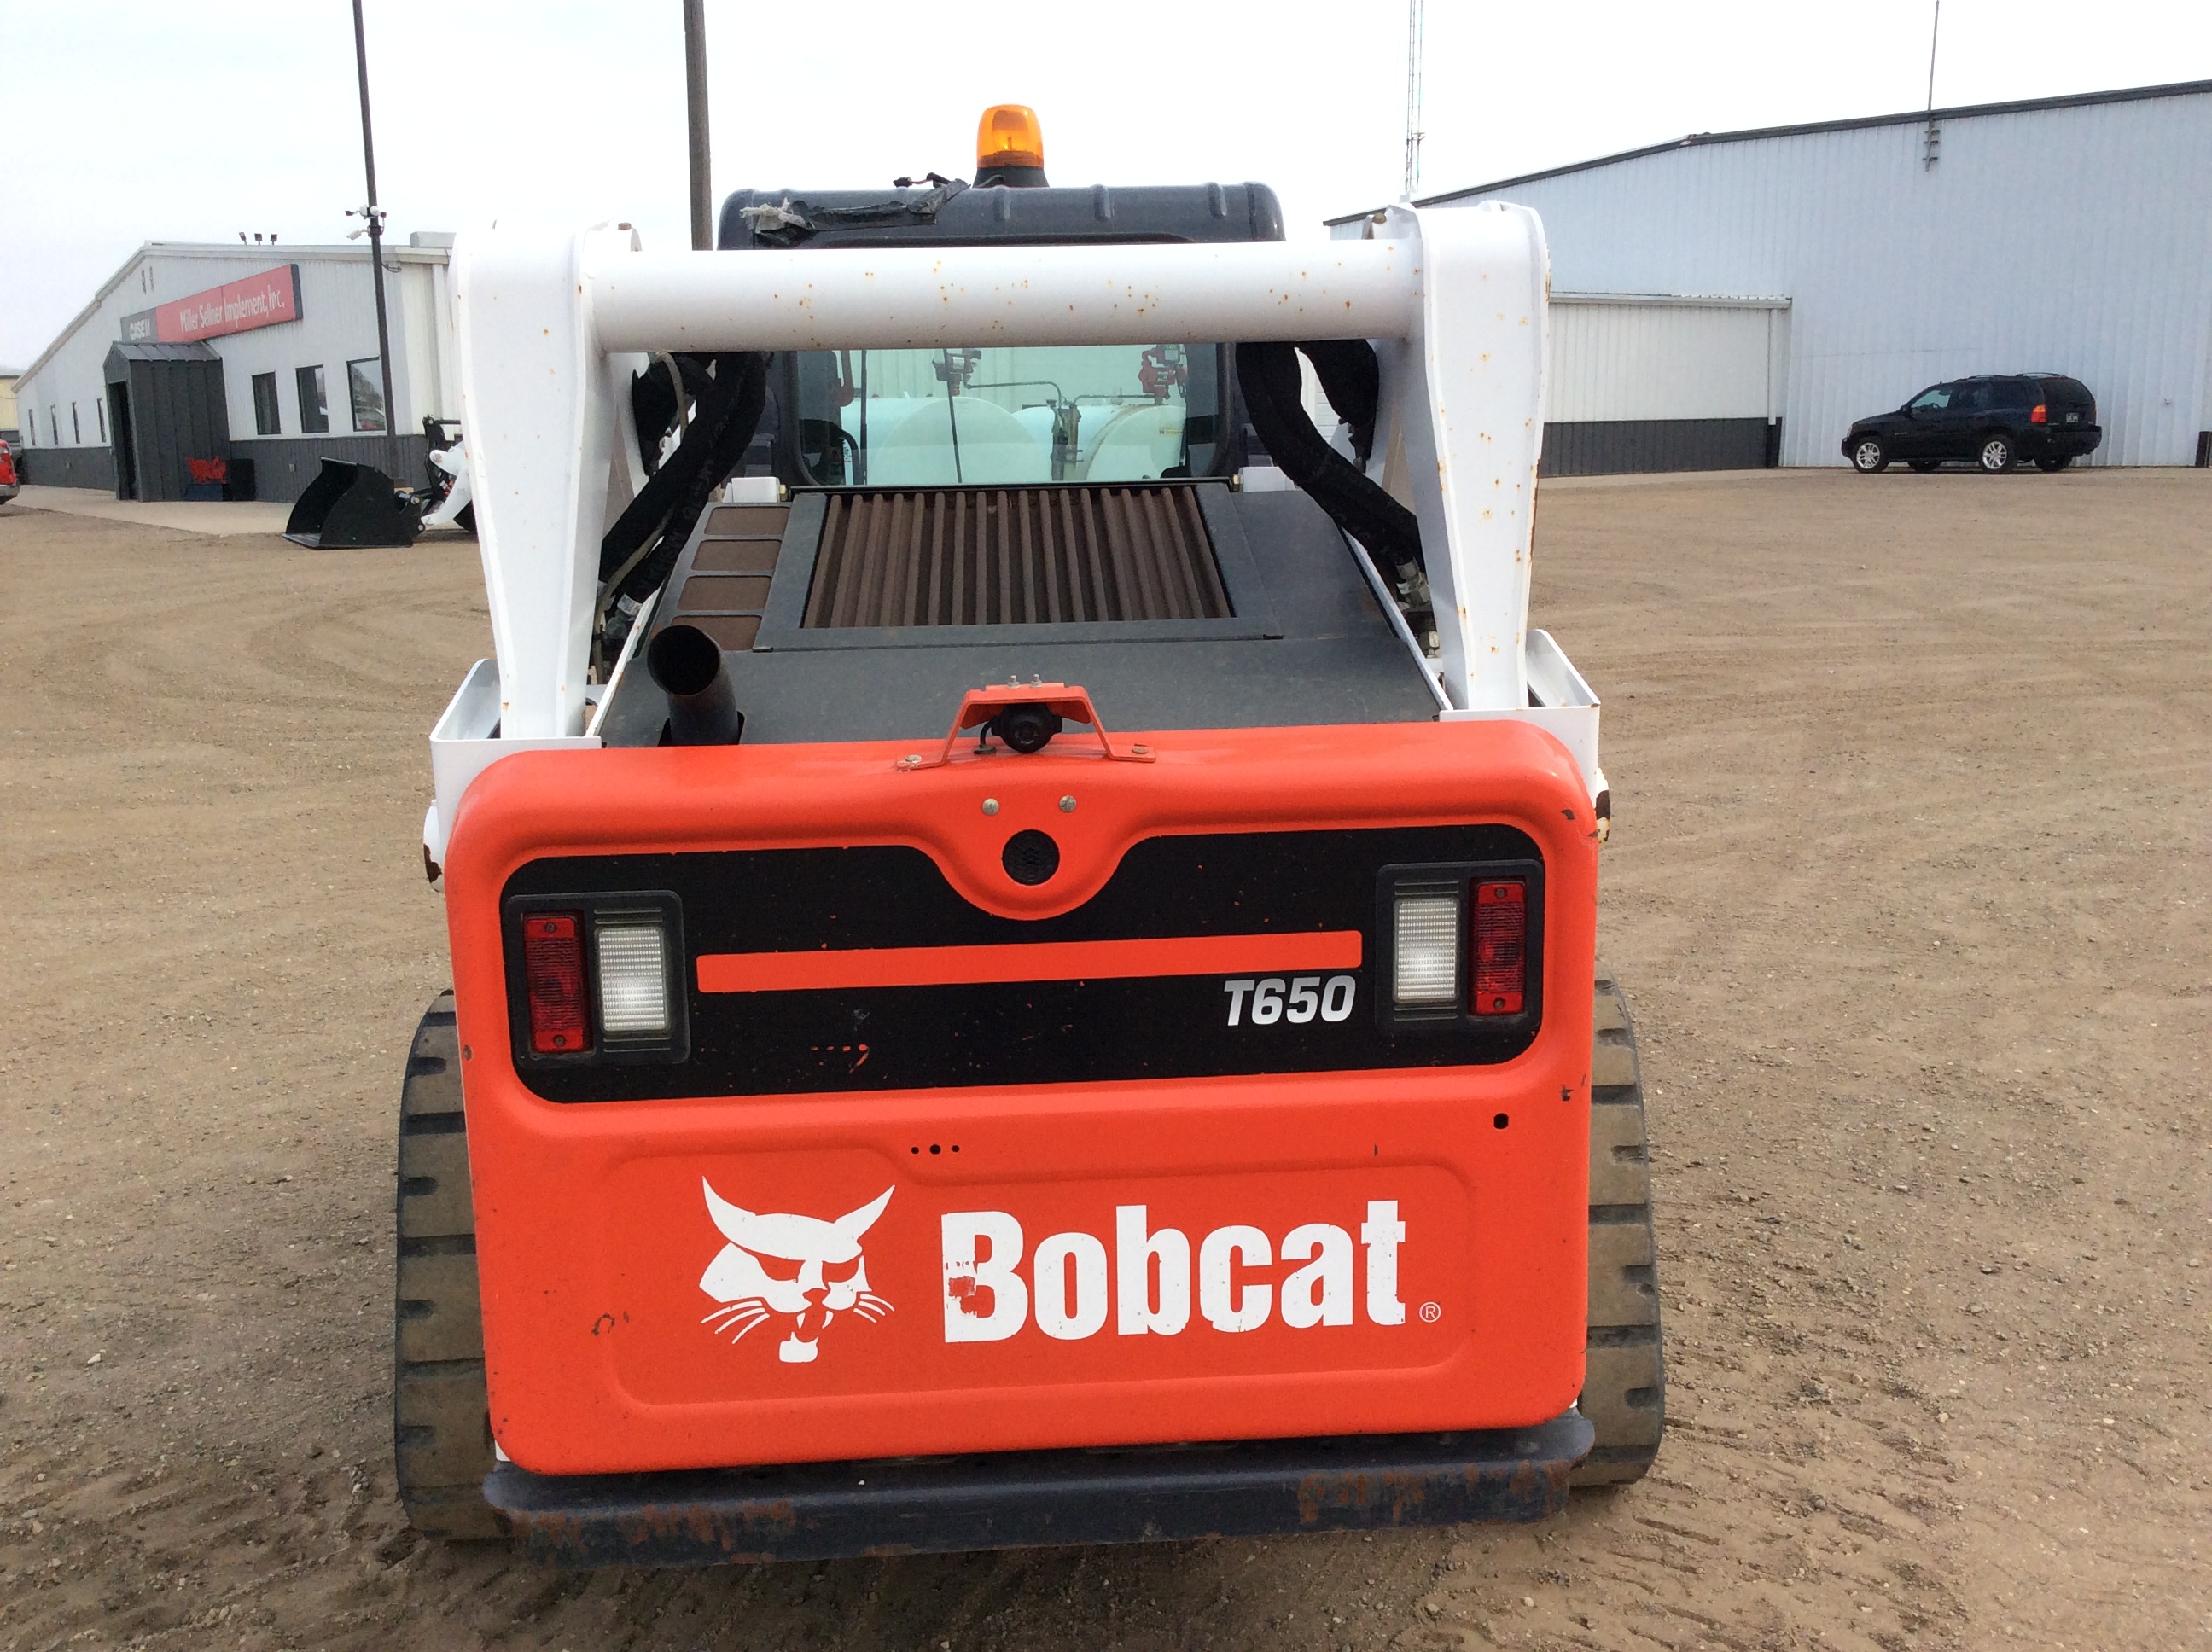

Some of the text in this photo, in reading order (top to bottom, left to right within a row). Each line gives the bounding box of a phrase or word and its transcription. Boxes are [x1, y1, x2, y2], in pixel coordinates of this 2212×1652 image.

[180, 308, 198, 334] Miller
[224, 292, 268, 329] Implement,
[267, 284, 285, 311] Inc.
[1224, 975, 1356, 1027] T650
[940, 1200, 1406, 1343] Bobcat
